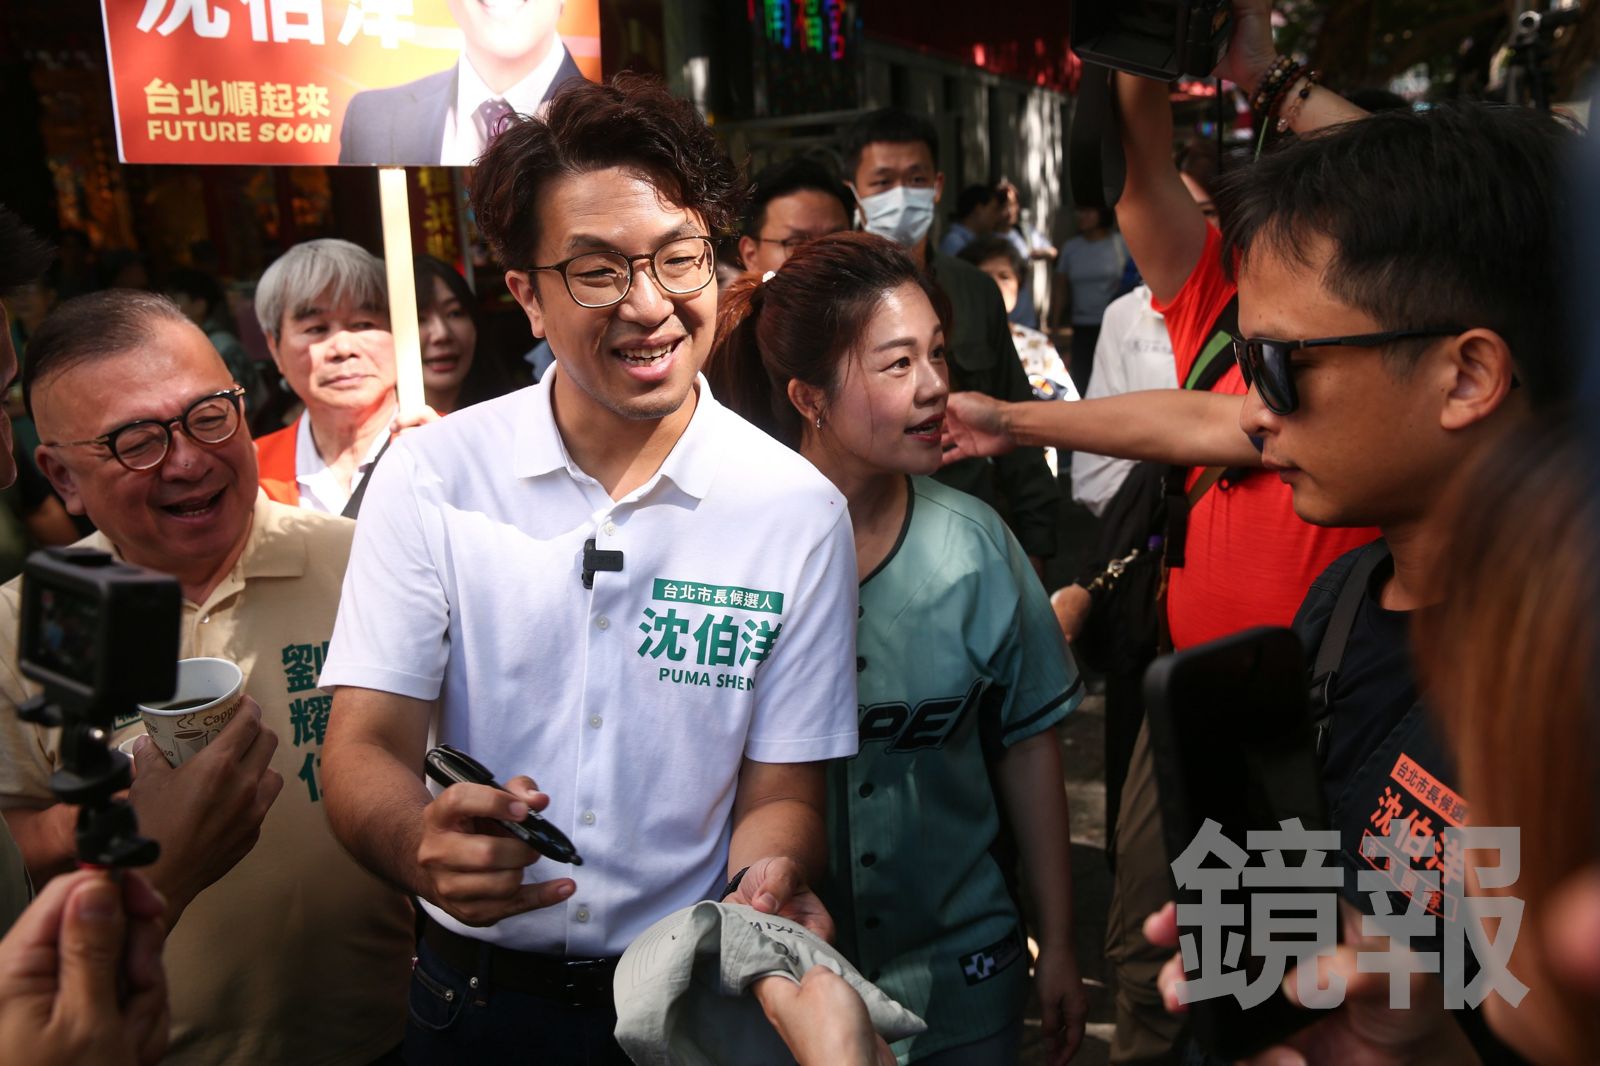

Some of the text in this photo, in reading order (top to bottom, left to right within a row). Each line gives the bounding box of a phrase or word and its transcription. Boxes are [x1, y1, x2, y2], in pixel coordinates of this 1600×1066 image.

[143, 77, 331, 119] 台北順起來
[147, 120, 332, 144] FUTURE SOON
[663, 583, 774, 610] 台北市長候選人
[637, 607, 783, 667] 沈伯洋
[658, 667, 711, 687] PUMA
